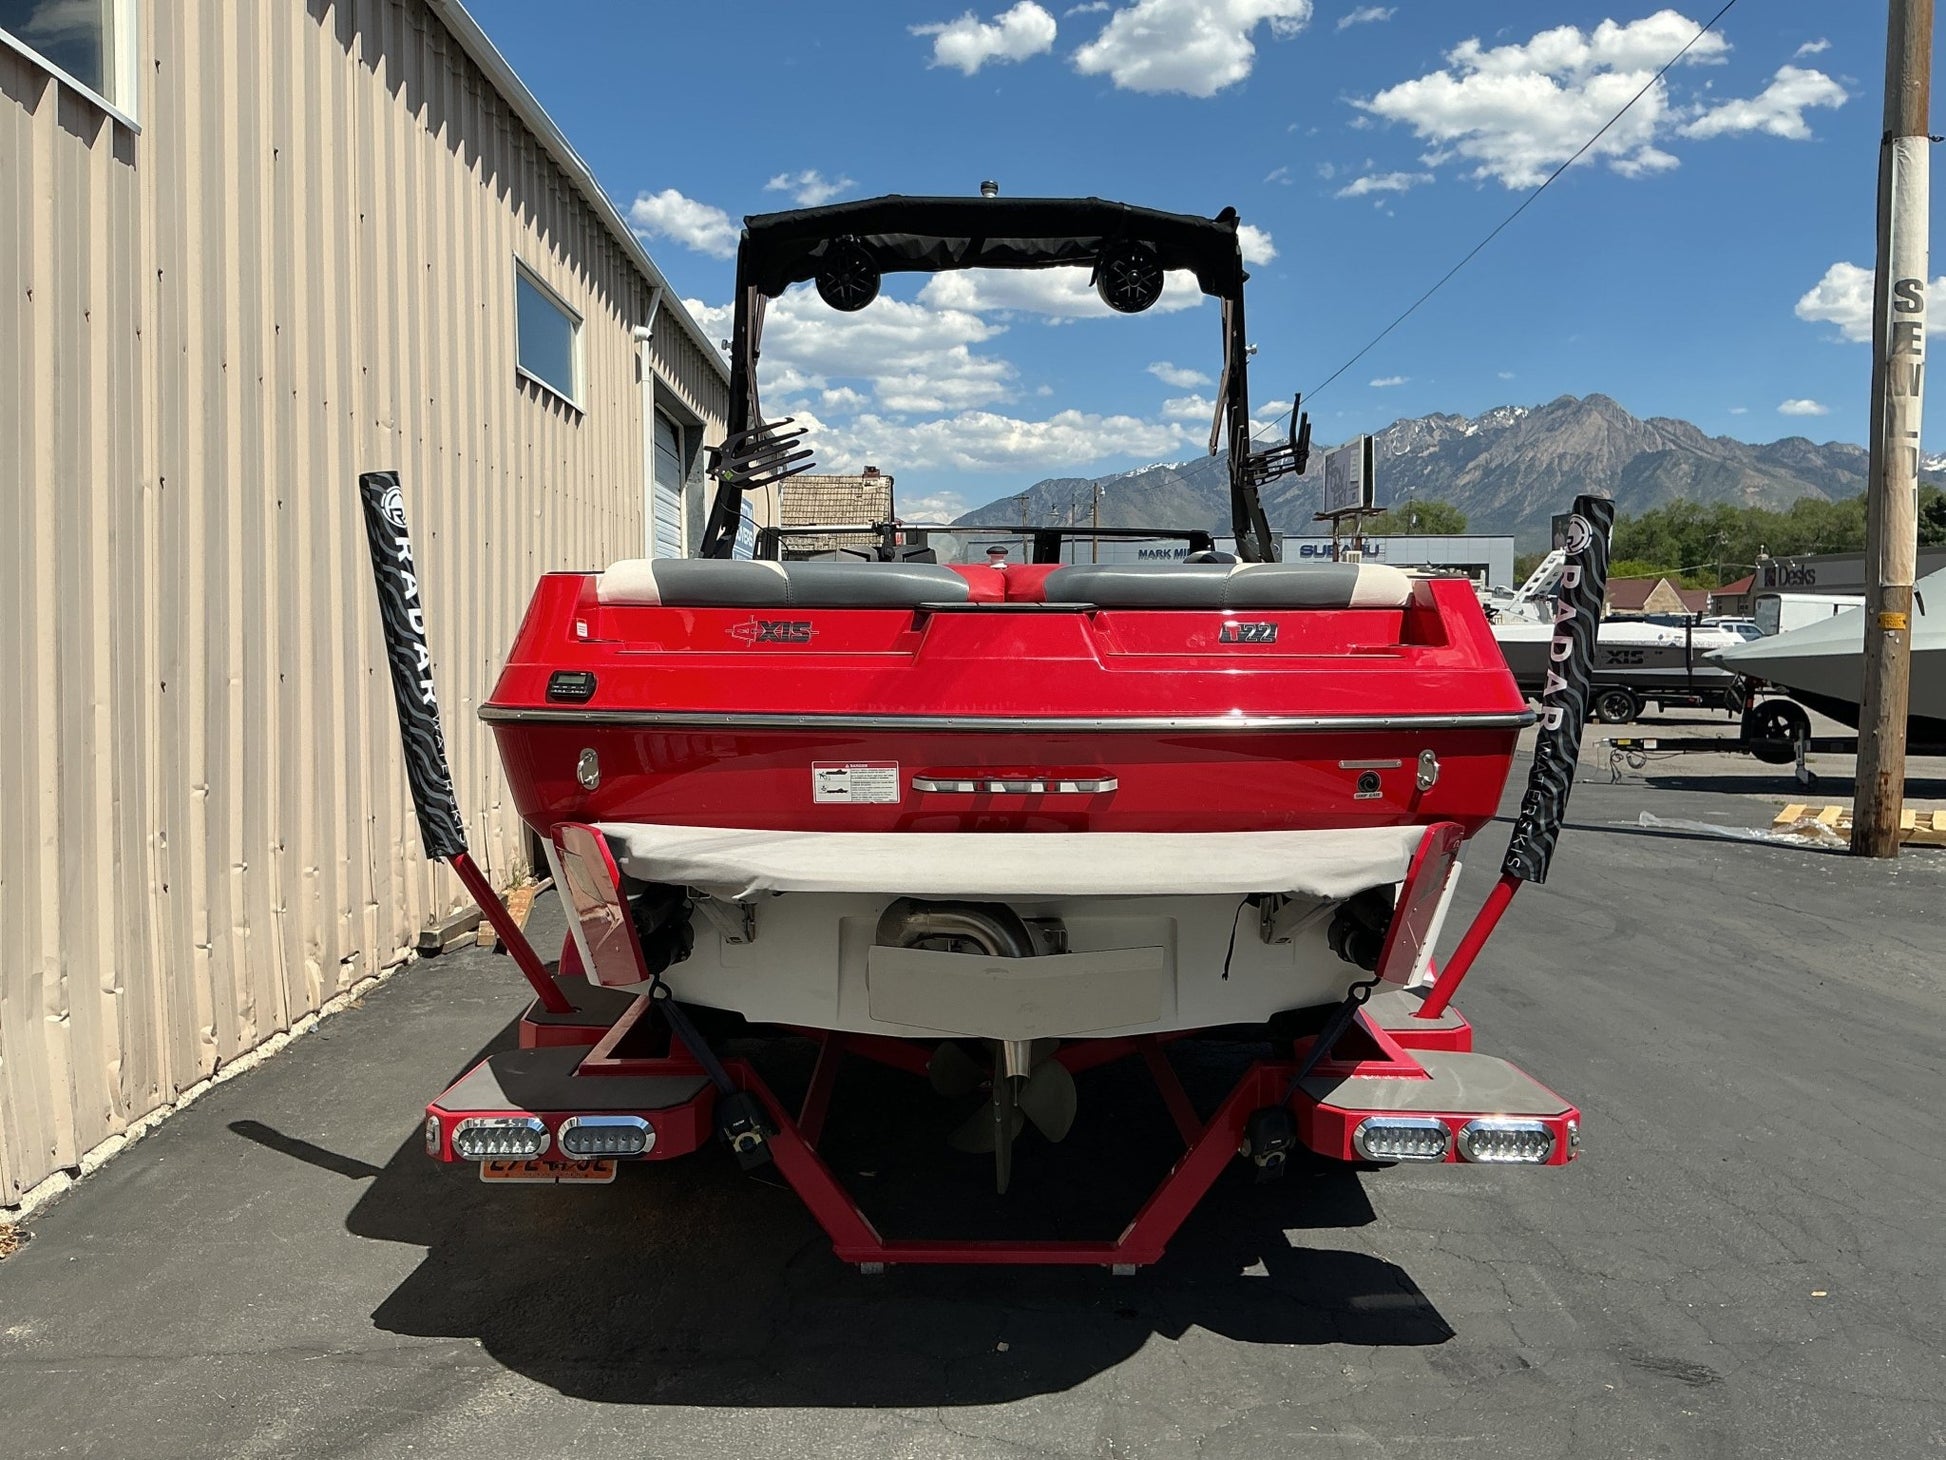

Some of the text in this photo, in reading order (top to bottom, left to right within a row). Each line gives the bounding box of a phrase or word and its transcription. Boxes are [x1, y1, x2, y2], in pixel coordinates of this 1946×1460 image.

[1138, 548, 1172, 559] MARK
[1299, 544, 1380, 557] SUBAU
[1778, 564, 1816, 586] Desks
[395, 537, 437, 705] RADAR
[1541, 564, 1582, 731] RADAR
[1507, 741, 1552, 868] WATERSKIS
